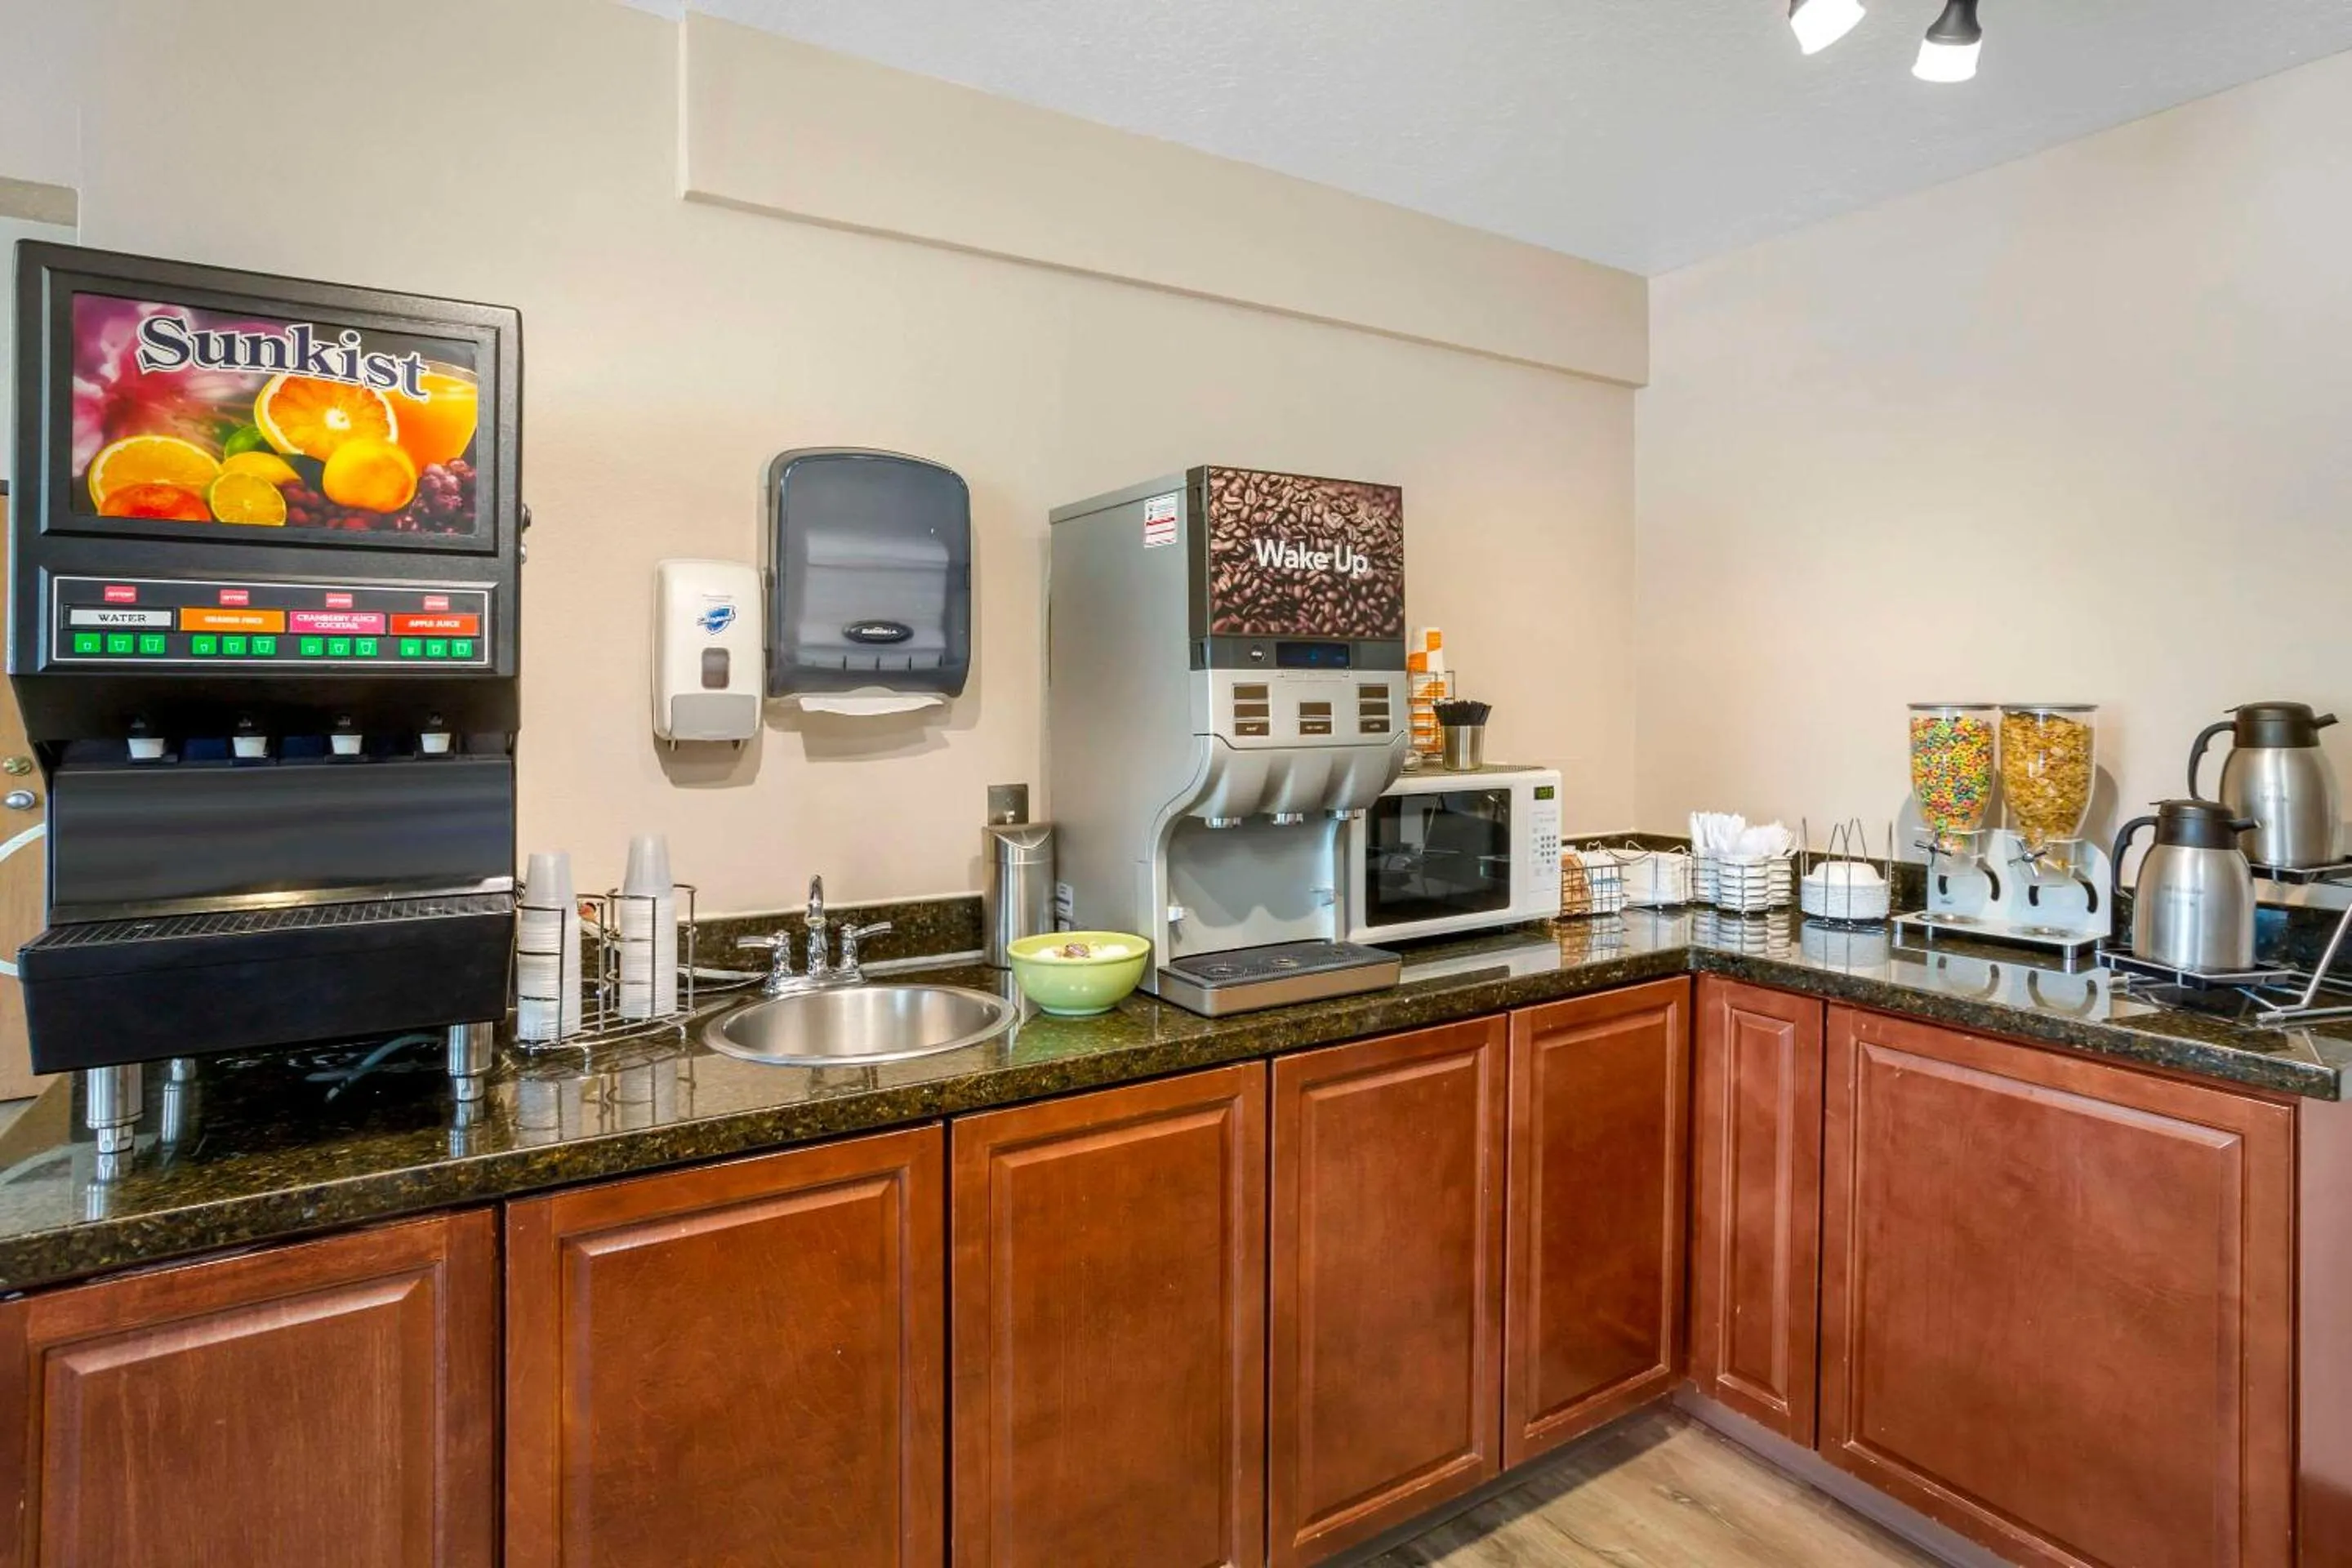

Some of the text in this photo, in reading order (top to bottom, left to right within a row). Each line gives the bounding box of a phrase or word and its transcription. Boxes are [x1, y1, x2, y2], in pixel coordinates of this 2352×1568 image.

[136, 315, 430, 402] Sunkist
[1254, 538, 1369, 579] Wake Up
[98, 613, 147, 622] WATER
